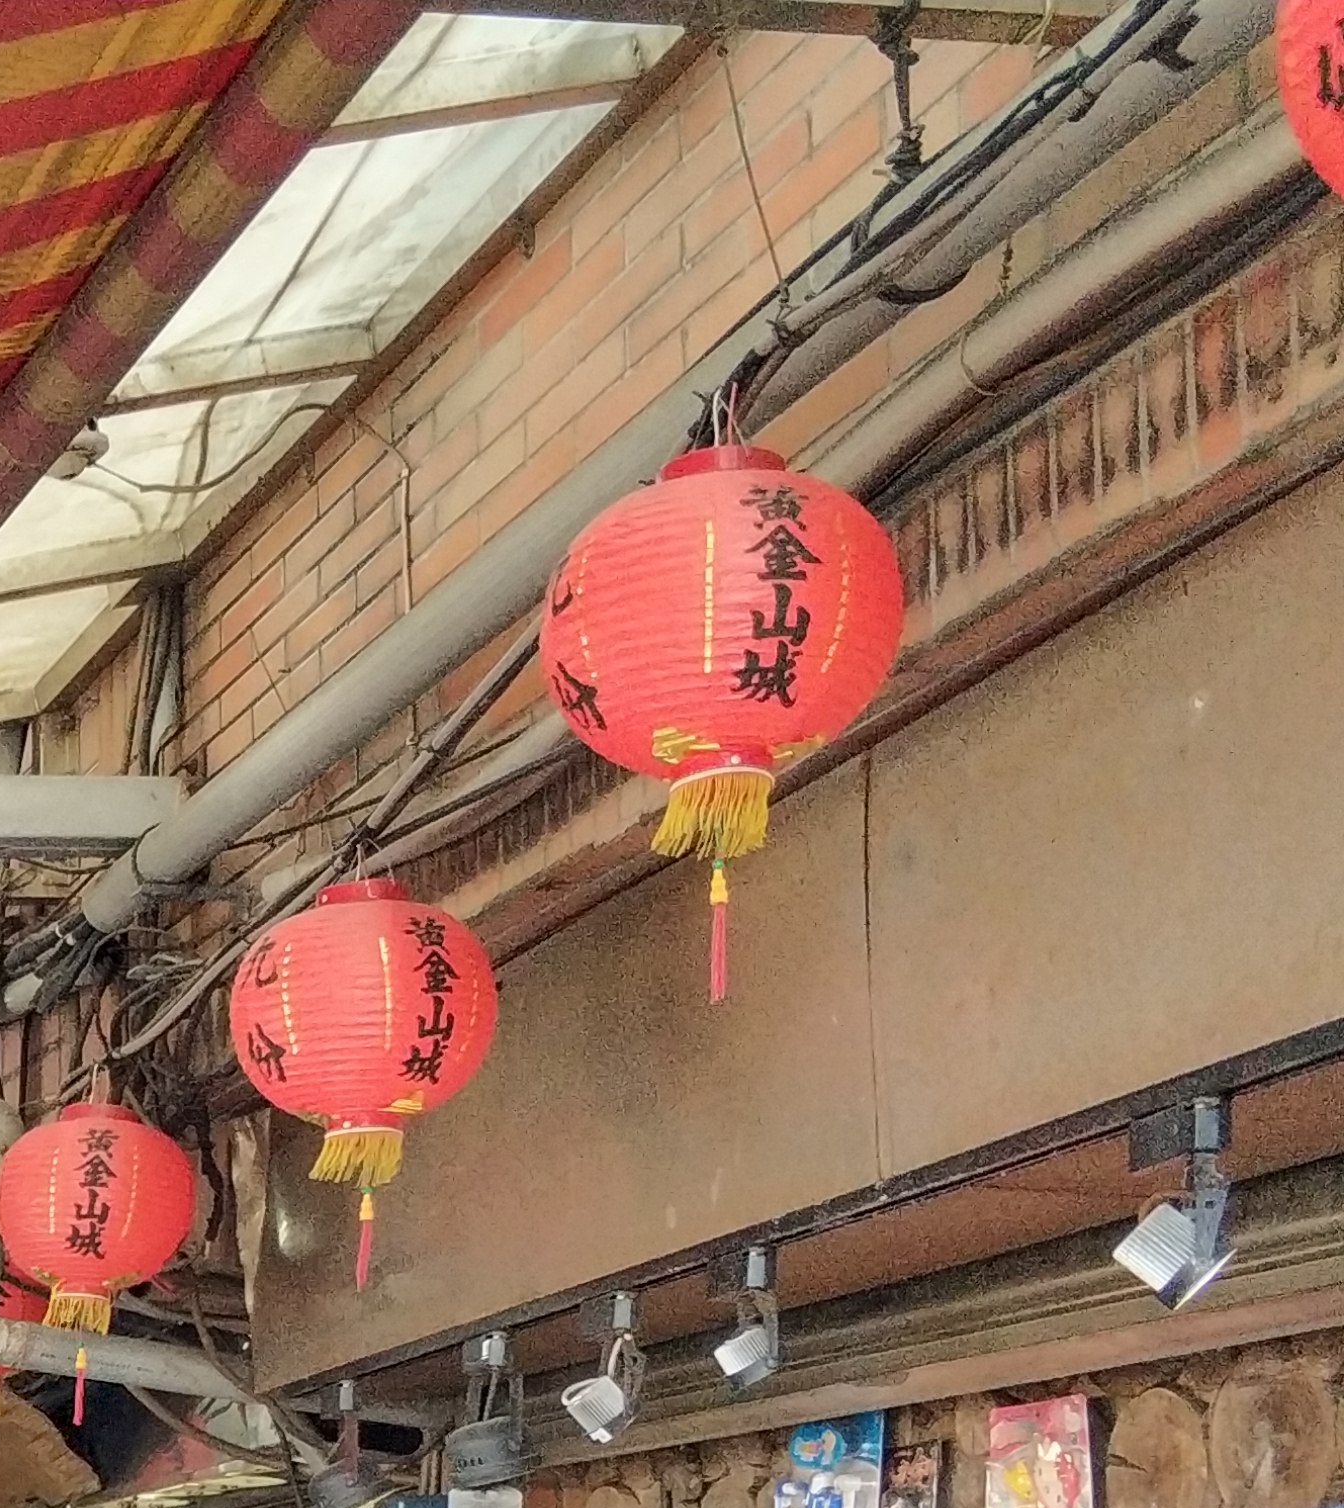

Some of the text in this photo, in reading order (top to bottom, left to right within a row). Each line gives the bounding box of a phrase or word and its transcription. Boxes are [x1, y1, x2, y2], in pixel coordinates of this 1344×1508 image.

[730, 484, 822, 709] 黃金山城
[398, 916, 460, 1085] 黃金山城
[64, 1128, 120, 1259] 黃金山城
